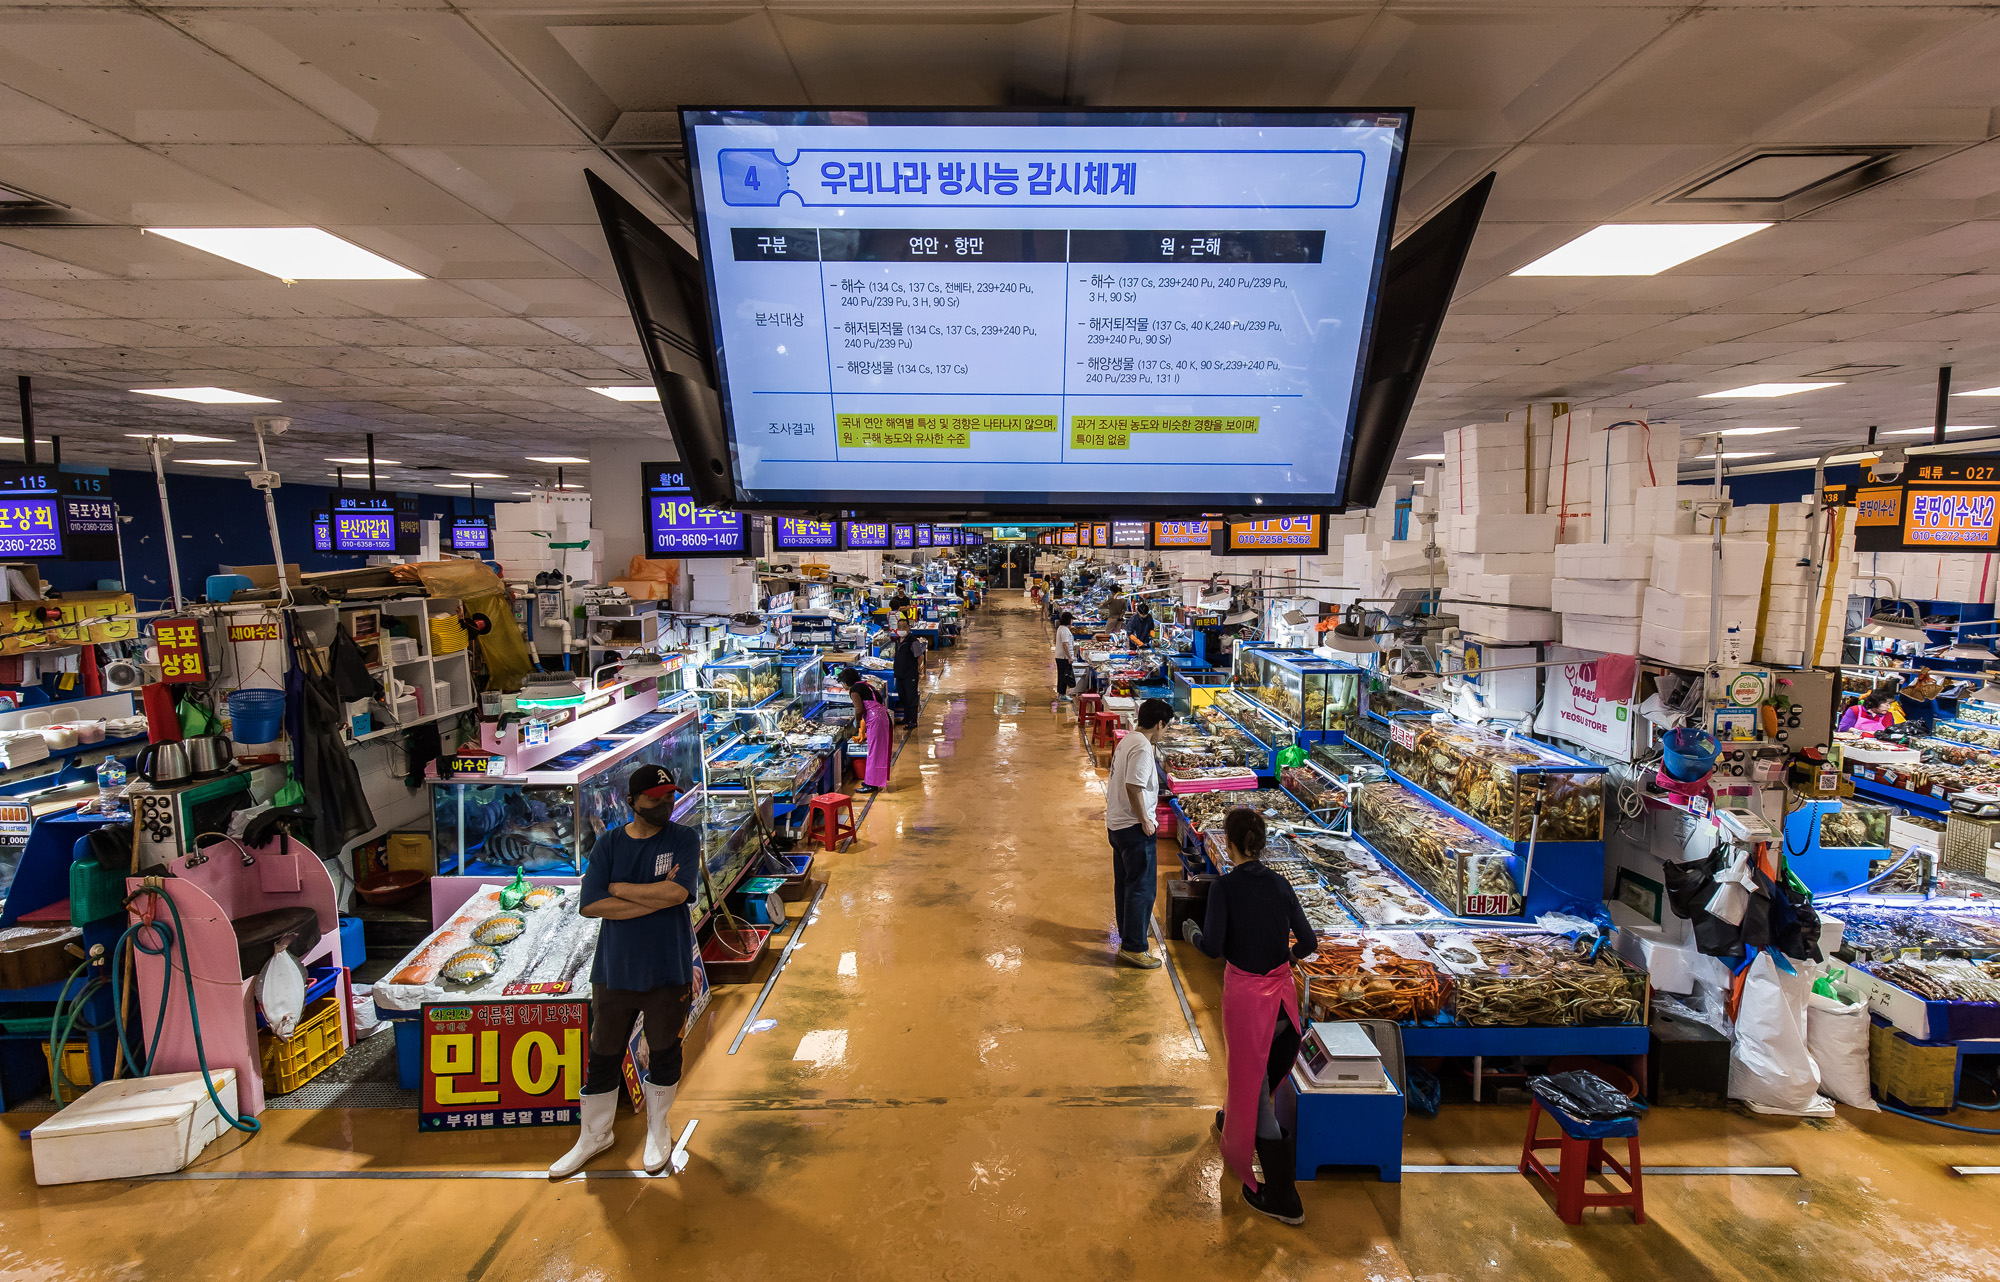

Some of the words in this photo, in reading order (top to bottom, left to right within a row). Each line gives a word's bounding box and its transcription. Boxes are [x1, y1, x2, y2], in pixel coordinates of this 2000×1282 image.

[744, 165, 761, 191] 4
[821, 161, 930, 195] 우리나라
[937, 161, 1020, 195] 방사능
[1026, 162, 1137, 196] 감시체계
[757, 236, 787, 255] 구분
[909, 237, 938, 256] 연안
[954, 237, 984, 256] 항만
[1160, 238, 1175, 256] 원
[1190, 238, 1221, 256] 근해
[841, 278, 866, 294] 해수
[868, 282, 890, 294] (134
[891, 282, 905, 294] Cs,
[908, 282, 923, 292] 137
[926, 282, 941, 294] Cs,
[945, 282, 974, 294] 전베타,
[976, 282, 1017, 293] 239+240
[1019, 282, 1034, 294] Pu,
[1091, 274, 1116, 289] 해수
[1118, 277, 1140, 289] (137
[1140, 277, 1156, 289] Cs,
[1158, 277, 1199, 288] 239+240
[1201, 277, 1215, 289] Pu,
[1217, 277, 1236, 288] 240
[1237, 277, 1272, 289] Pu/239
[1273, 277, 1288, 289] Pu,
[841, 296, 860, 307] 240
[861, 296, 894, 308] Pu/239
[896, 296, 910, 308] Pu,
[912, 297, 918, 307] 3
[920, 296, 931, 308] H,
[933, 297, 945, 307] 90
[947, 296, 960, 308] Sr)
[1088, 291, 1096, 302] 3
[1097, 291, 1107, 303] H,
[1110, 292, 1122, 302] 90
[1123, 291, 1137, 303] Sr)
[755, 312, 804, 328] 분석대상
[1089, 317, 1149, 332] 해저퇴적물
[1152, 320, 1172, 332] (137
[1174, 320, 1189, 332] Cs,
[1190, 320, 1203, 331] 40
[1204, 320, 1231, 332] K,240
[1232, 320, 1267, 332] Pu/239
[1268, 320, 1282, 332] Pu,
[844, 321, 904, 336] 해저퇴적물
[906, 324, 927, 337] (134
[929, 324, 943, 337] Cs,
[946, 325, 961, 336] 137
[963, 324, 978, 337] Cs,
[981, 325, 1022, 336] 239+240
[1023, 324, 1037, 337] Pu,
[844, 339, 862, 349] 240
[863, 338, 897, 350] Pu/239
[898, 338, 913, 350] Pu)
[1087, 334, 1127, 345] 239+240
[1128, 334, 1143, 346] Pu,
[1145, 334, 1157, 345] 90
[1159, 334, 1172, 346] Sr)
[847, 361, 893, 376] 해양생물
[897, 363, 917, 376] (134
[918, 363, 934, 376] Cs,
[936, 363, 951, 374] 137
[953, 363, 968, 376] Cs)
[1087, 357, 1135, 372] 해양생물
[1137, 360, 1158, 372] (137
[1159, 360, 1173, 372] Cs,
[1175, 360, 1188, 371] 40
[1189, 360, 1199, 372] K,
[1200, 360, 1212, 371] 90
[1214, 360, 1264, 372] Sr,239+240
[1266, 360, 1281, 372] Pu,
[1085, 373, 1103, 384] 240
[1104, 373, 1138, 385] Pu/239
[1139, 373, 1153, 385] Pu,
[1156, 374, 1173, 384] 131
[1174, 373, 1180, 385] I)
[768, 422, 815, 436] 조사결과
[841, 417, 861, 431] 국내
[863, 417, 883, 431] 연안
[885, 417, 915, 431] 해역별
[917, 417, 937, 431] 특성
[939, 417, 949, 431] 및
[952, 417, 981, 431] 경향은
[983, 417, 1022, 431] 나타나지
[1024, 418, 1057, 432] 않으며,
[1076, 419, 1097, 431] 과거
[1098, 419, 1128, 431] 조사된
[1129, 419, 1160, 431] 농도와
[1162, 419, 1191, 431] 비슷한
[1193, 419, 1223, 432] 경향을
[1225, 419, 1258, 433] 보이며,
[844, 433, 853, 445] 원
[862, 433, 882, 445] 근해
[883, 433, 913, 445] 농도와
[915, 433, 944, 445] 유사한
[946, 433, 966, 445] 수준
[1075, 433, 1105, 446] 특이점
[1106, 433, 1127, 446] 없음
[660, 472, 685, 486] 활어
[1918, 466, 1944, 480] 패류
[1966, 467, 1995, 480] 027
[20, 475, 46, 489] 115
[74, 478, 101, 492] 115
[68, 503, 112, 519] 목포상회
[369, 499, 388, 508] 114
[1912, 495, 1996, 528] 복띵이수산2
[70, 523, 114, 531] 010-2360-2258
[340, 519, 391, 539] 부산자갈치
[850, 524, 886, 538] 충남미림
[895, 528, 911, 540] 상회
[658, 533, 739, 547] 010-8609-1407
[783, 537, 833, 545] 010-3202-9395
[1238, 535, 1311, 545] 010-2258-5362
[1912, 530, 1989, 542] 010-6272-3214
[157, 626, 198, 649] 목포
[162, 653, 201, 676] 상회
[1560, 710, 1585, 725] YEOSU
[1584, 717, 1608, 733] STORE
[1391, 724, 1413, 750] 킹크랩
[657, 769, 671, 784] A
[1465, 894, 1510, 915] 대게
[433, 1010, 470, 1021] 자연산
[478, 1006, 516, 1027] 여름철
[518, 1005, 543, 1025] 인기
[546, 1004, 583, 1025] 보양식
[435, 1022, 468, 1032] 국내산
[430, 1028, 582, 1106] 민어
[446, 1112, 495, 1128] 부위별
[502, 1111, 534, 1125] 분할
[540, 1109, 571, 1124] 판매
